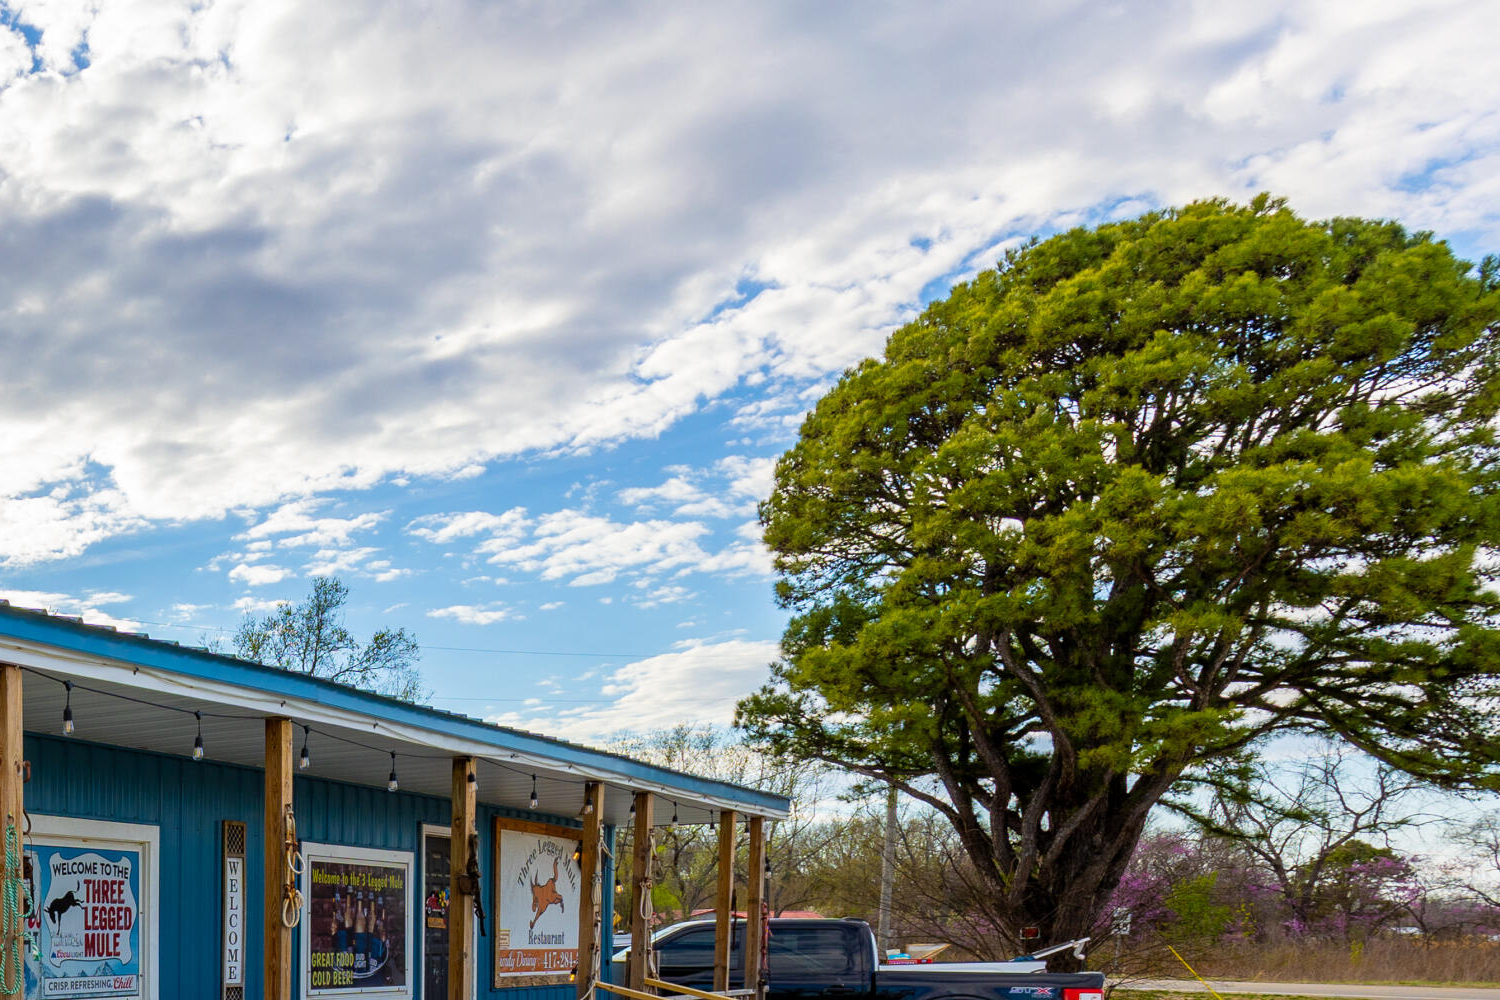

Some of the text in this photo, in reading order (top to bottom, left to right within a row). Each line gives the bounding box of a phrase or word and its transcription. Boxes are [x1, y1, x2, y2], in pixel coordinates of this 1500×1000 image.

[53, 862, 130, 880] WELCOME TO THE
[517, 839, 576, 892] Three Legged Mule
[312, 868, 340, 885] Welcome
[342, 872, 348, 886] to
[350, 871, 360, 886] the
[368, 873, 388, 892] Legged
[389, 874, 403, 889] Mule
[84, 878, 125, 905] THREE
[84, 905, 132, 931] LEGGED
[228, 861, 240, 980] WELCOME
[84, 932, 121, 958] MULE
[528, 929, 565, 945] Restaurant
[311, 952, 334, 968] GREAT
[336, 952, 354, 968] FOOD
[516, 950, 537, 971] Dining
[48, 976, 133, 991] CRISP. REFRESHING. Chill
[312, 970, 354, 986] COLD BEER!
